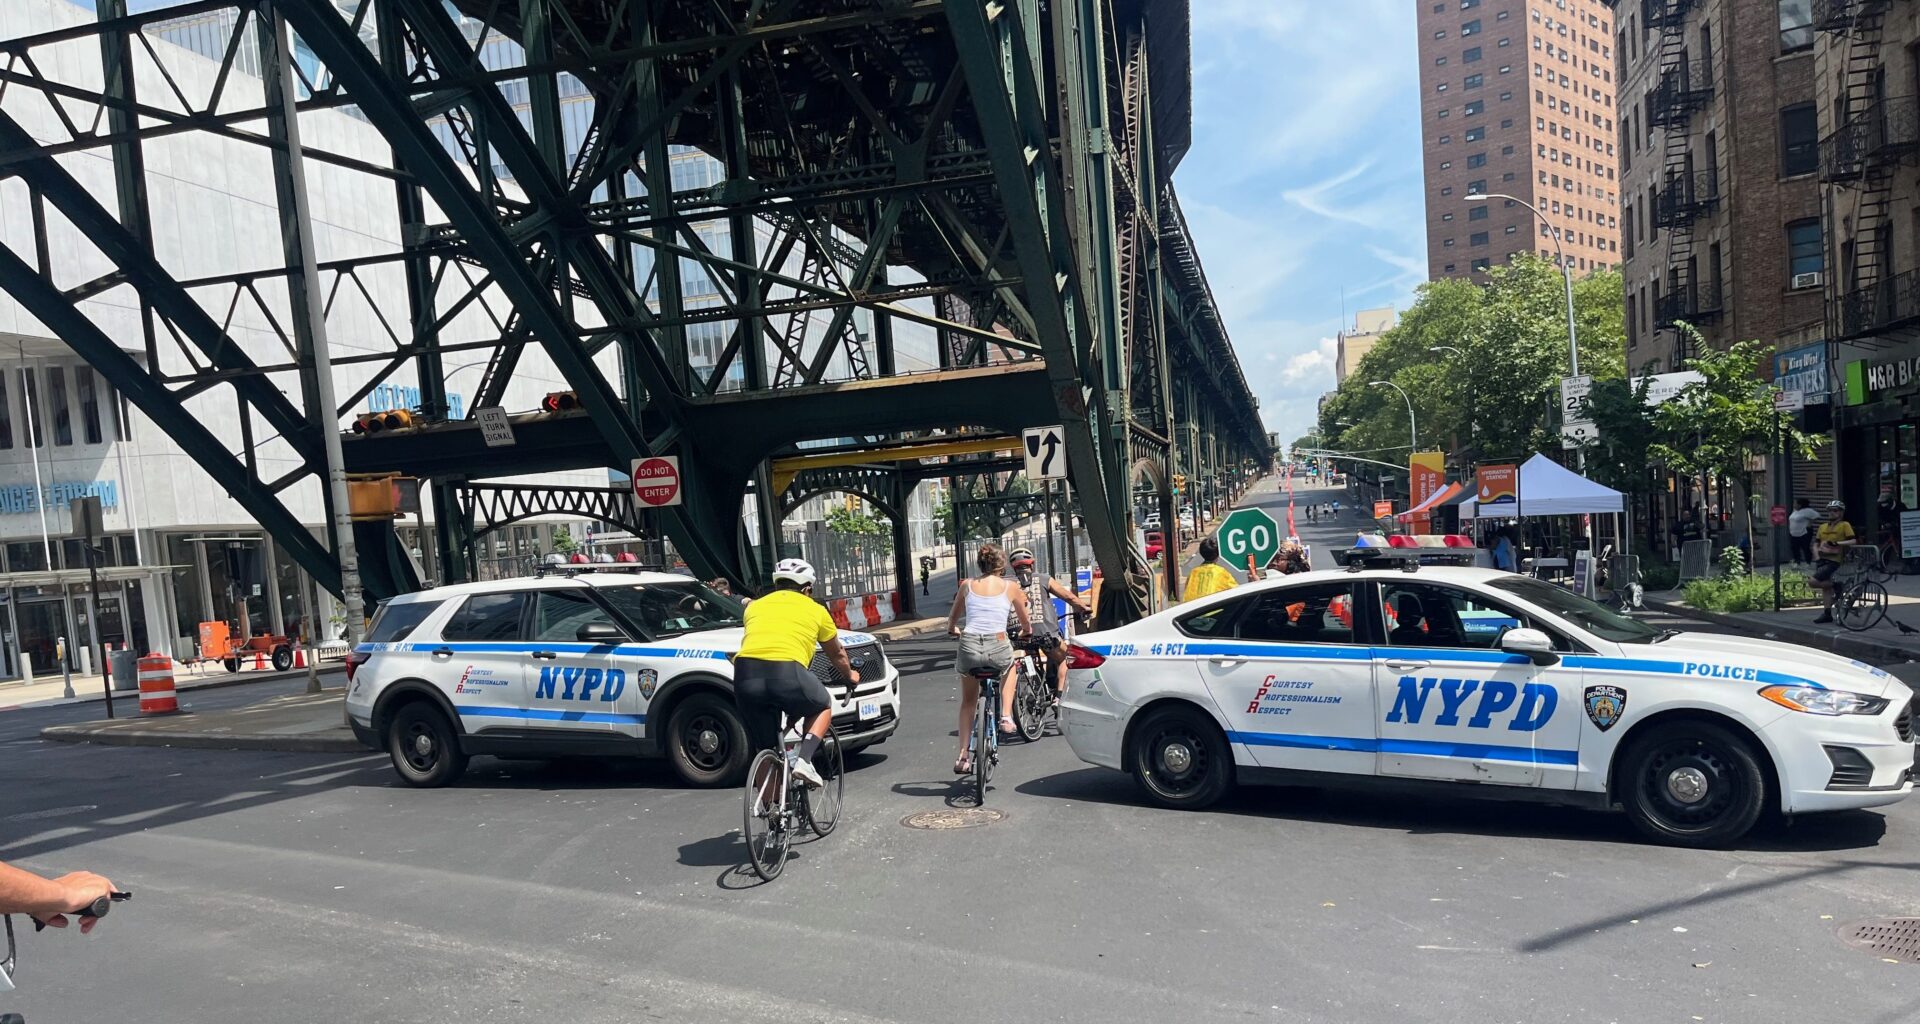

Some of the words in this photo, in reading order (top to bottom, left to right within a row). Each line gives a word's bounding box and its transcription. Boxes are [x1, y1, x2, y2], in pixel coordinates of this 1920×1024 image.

[1868, 363, 1896, 391] H&R
[483, 413, 500, 422] LEFT
[486, 423, 506, 431] TURN
[486, 432, 513, 442] SIGNAL
[655, 467, 669, 475] NOT
[645, 488, 670, 497] ENTER
[1227, 525, 1270, 555] GO
[676, 649, 712, 658] POLICE
[1112, 644, 1134, 656] 3289
[1151, 644, 1162, 655] 46
[1166, 644, 1183, 655] PCT
[465, 665, 493, 675] COURTESY
[1684, 662, 1755, 681] POLICE
[460, 674, 508, 685] PROFESSIONALISM
[536, 667, 625, 702] NYPD
[1263, 675, 1313, 689] COURTESY
[456, 684, 482, 694] RESPECT
[1255, 688, 1342, 704] PROFESSIONALISM
[1587, 691, 1624, 700] DEPARTMENT
[1246, 701, 1292, 714] RESPECT
[1385, 676, 1558, 732] NYPD
